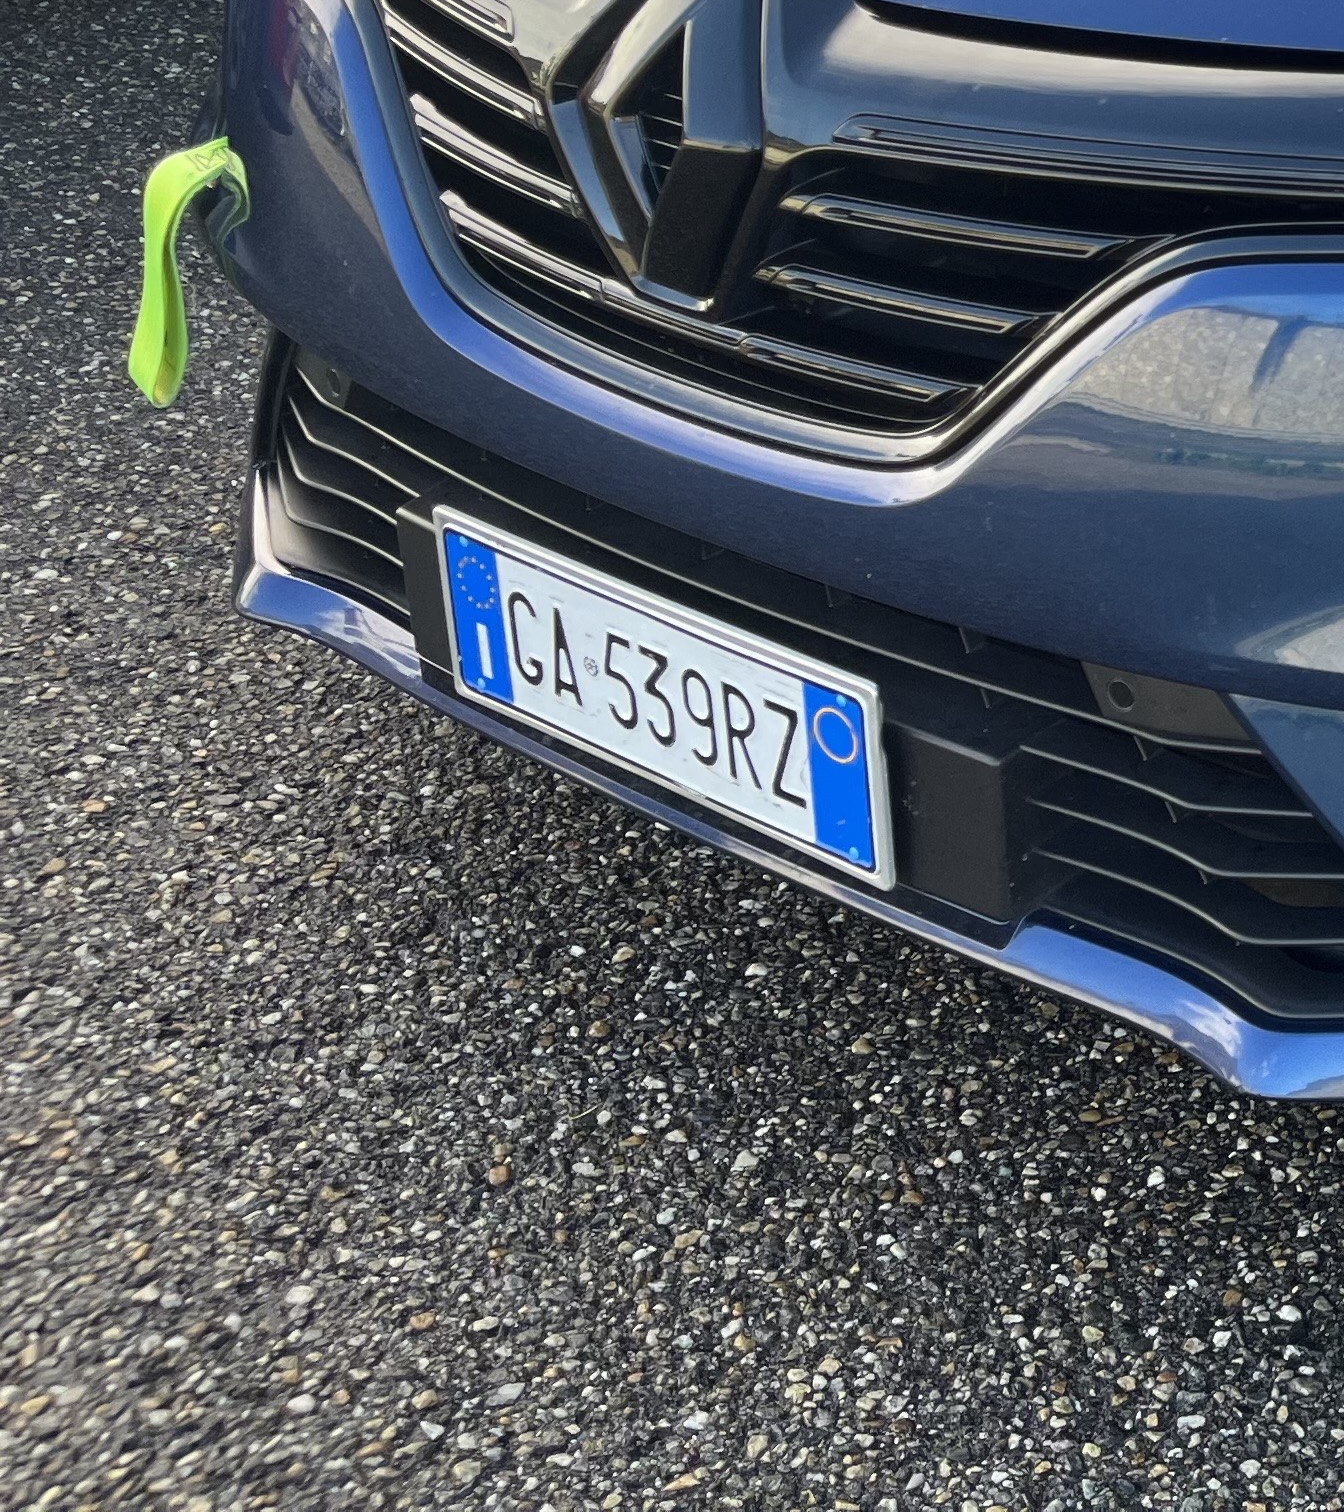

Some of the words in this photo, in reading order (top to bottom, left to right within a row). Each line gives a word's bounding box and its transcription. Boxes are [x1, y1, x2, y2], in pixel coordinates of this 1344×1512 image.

[476, 623, 494, 680] I
[507, 592, 583, 707] GA
[603, 632, 807, 810] 539RZ
